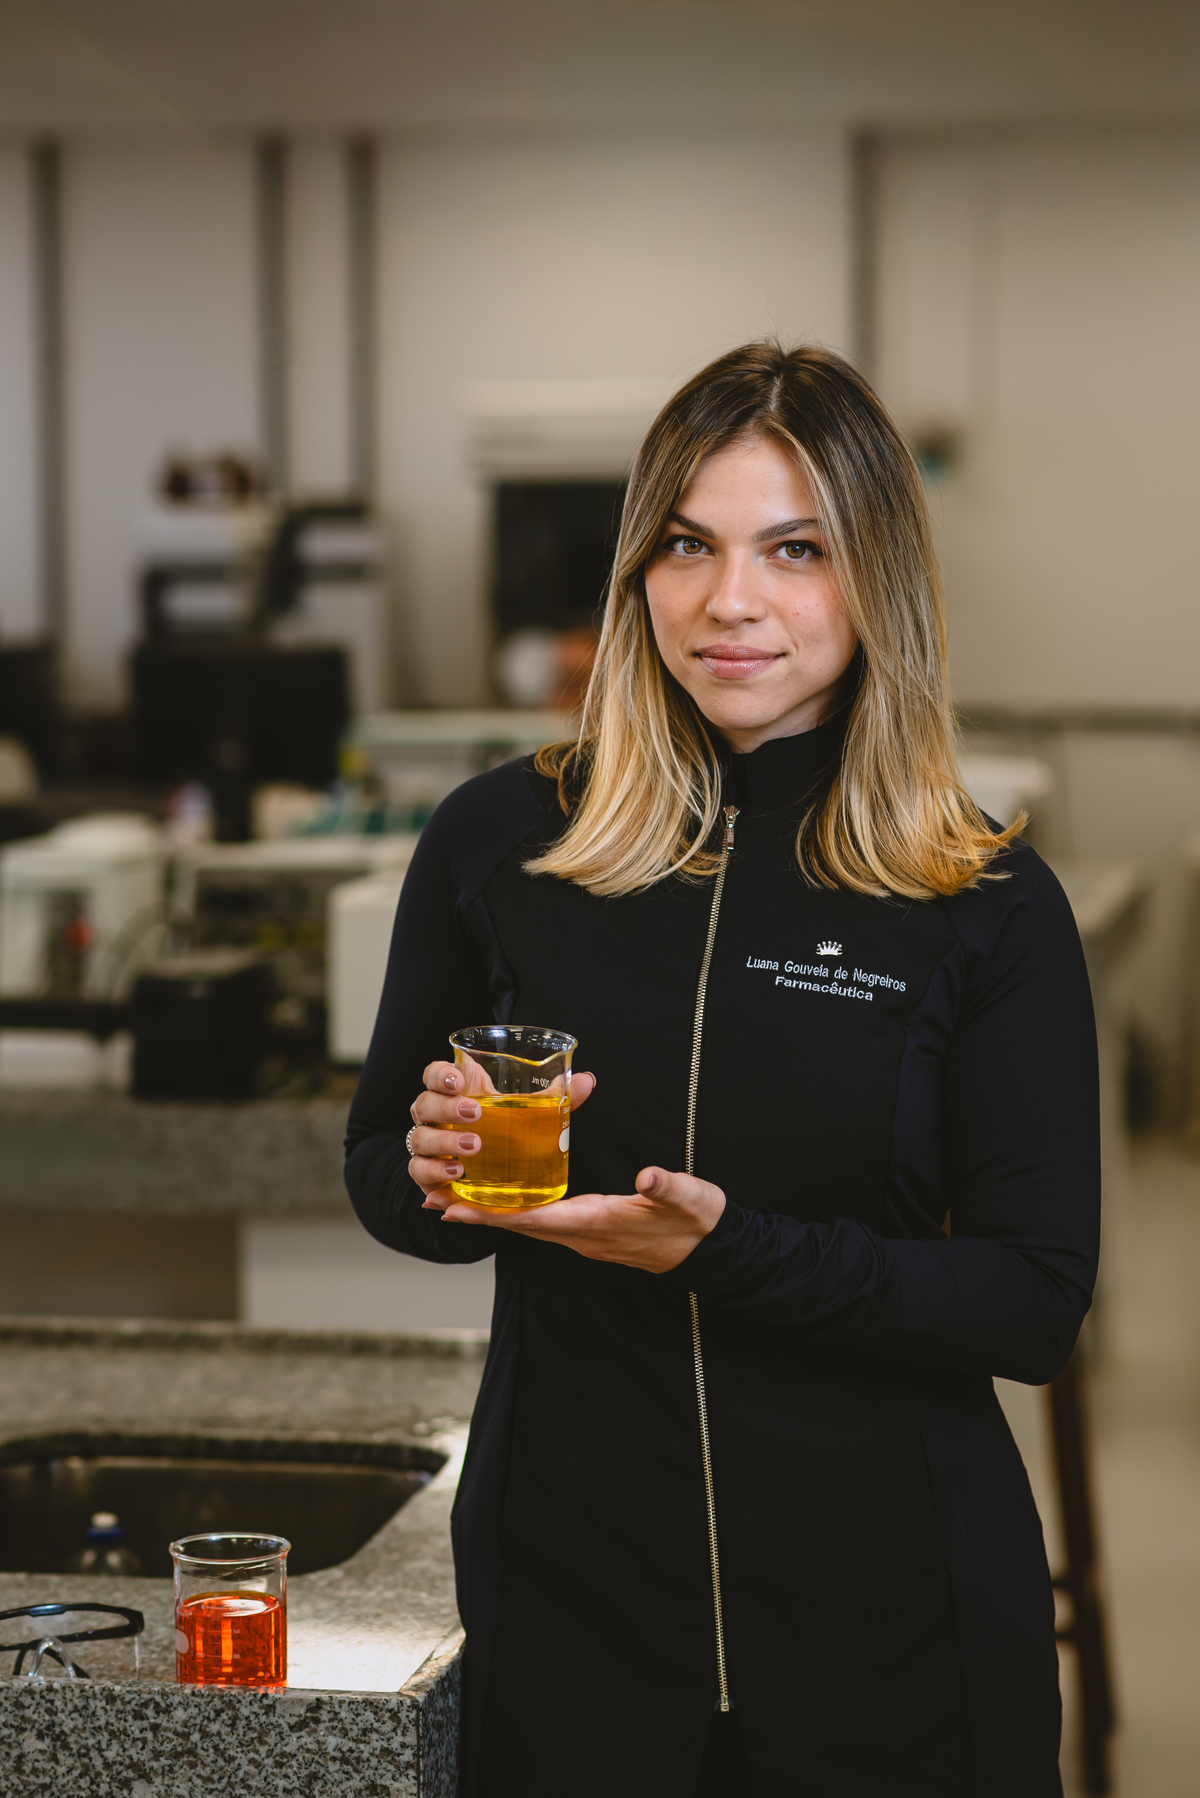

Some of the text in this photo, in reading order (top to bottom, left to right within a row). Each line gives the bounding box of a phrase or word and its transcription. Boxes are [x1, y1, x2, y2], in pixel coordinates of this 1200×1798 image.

[746, 956, 907, 992] Luana Gouveia de Negreiros
[775, 975, 874, 1002] Farmacêutica
